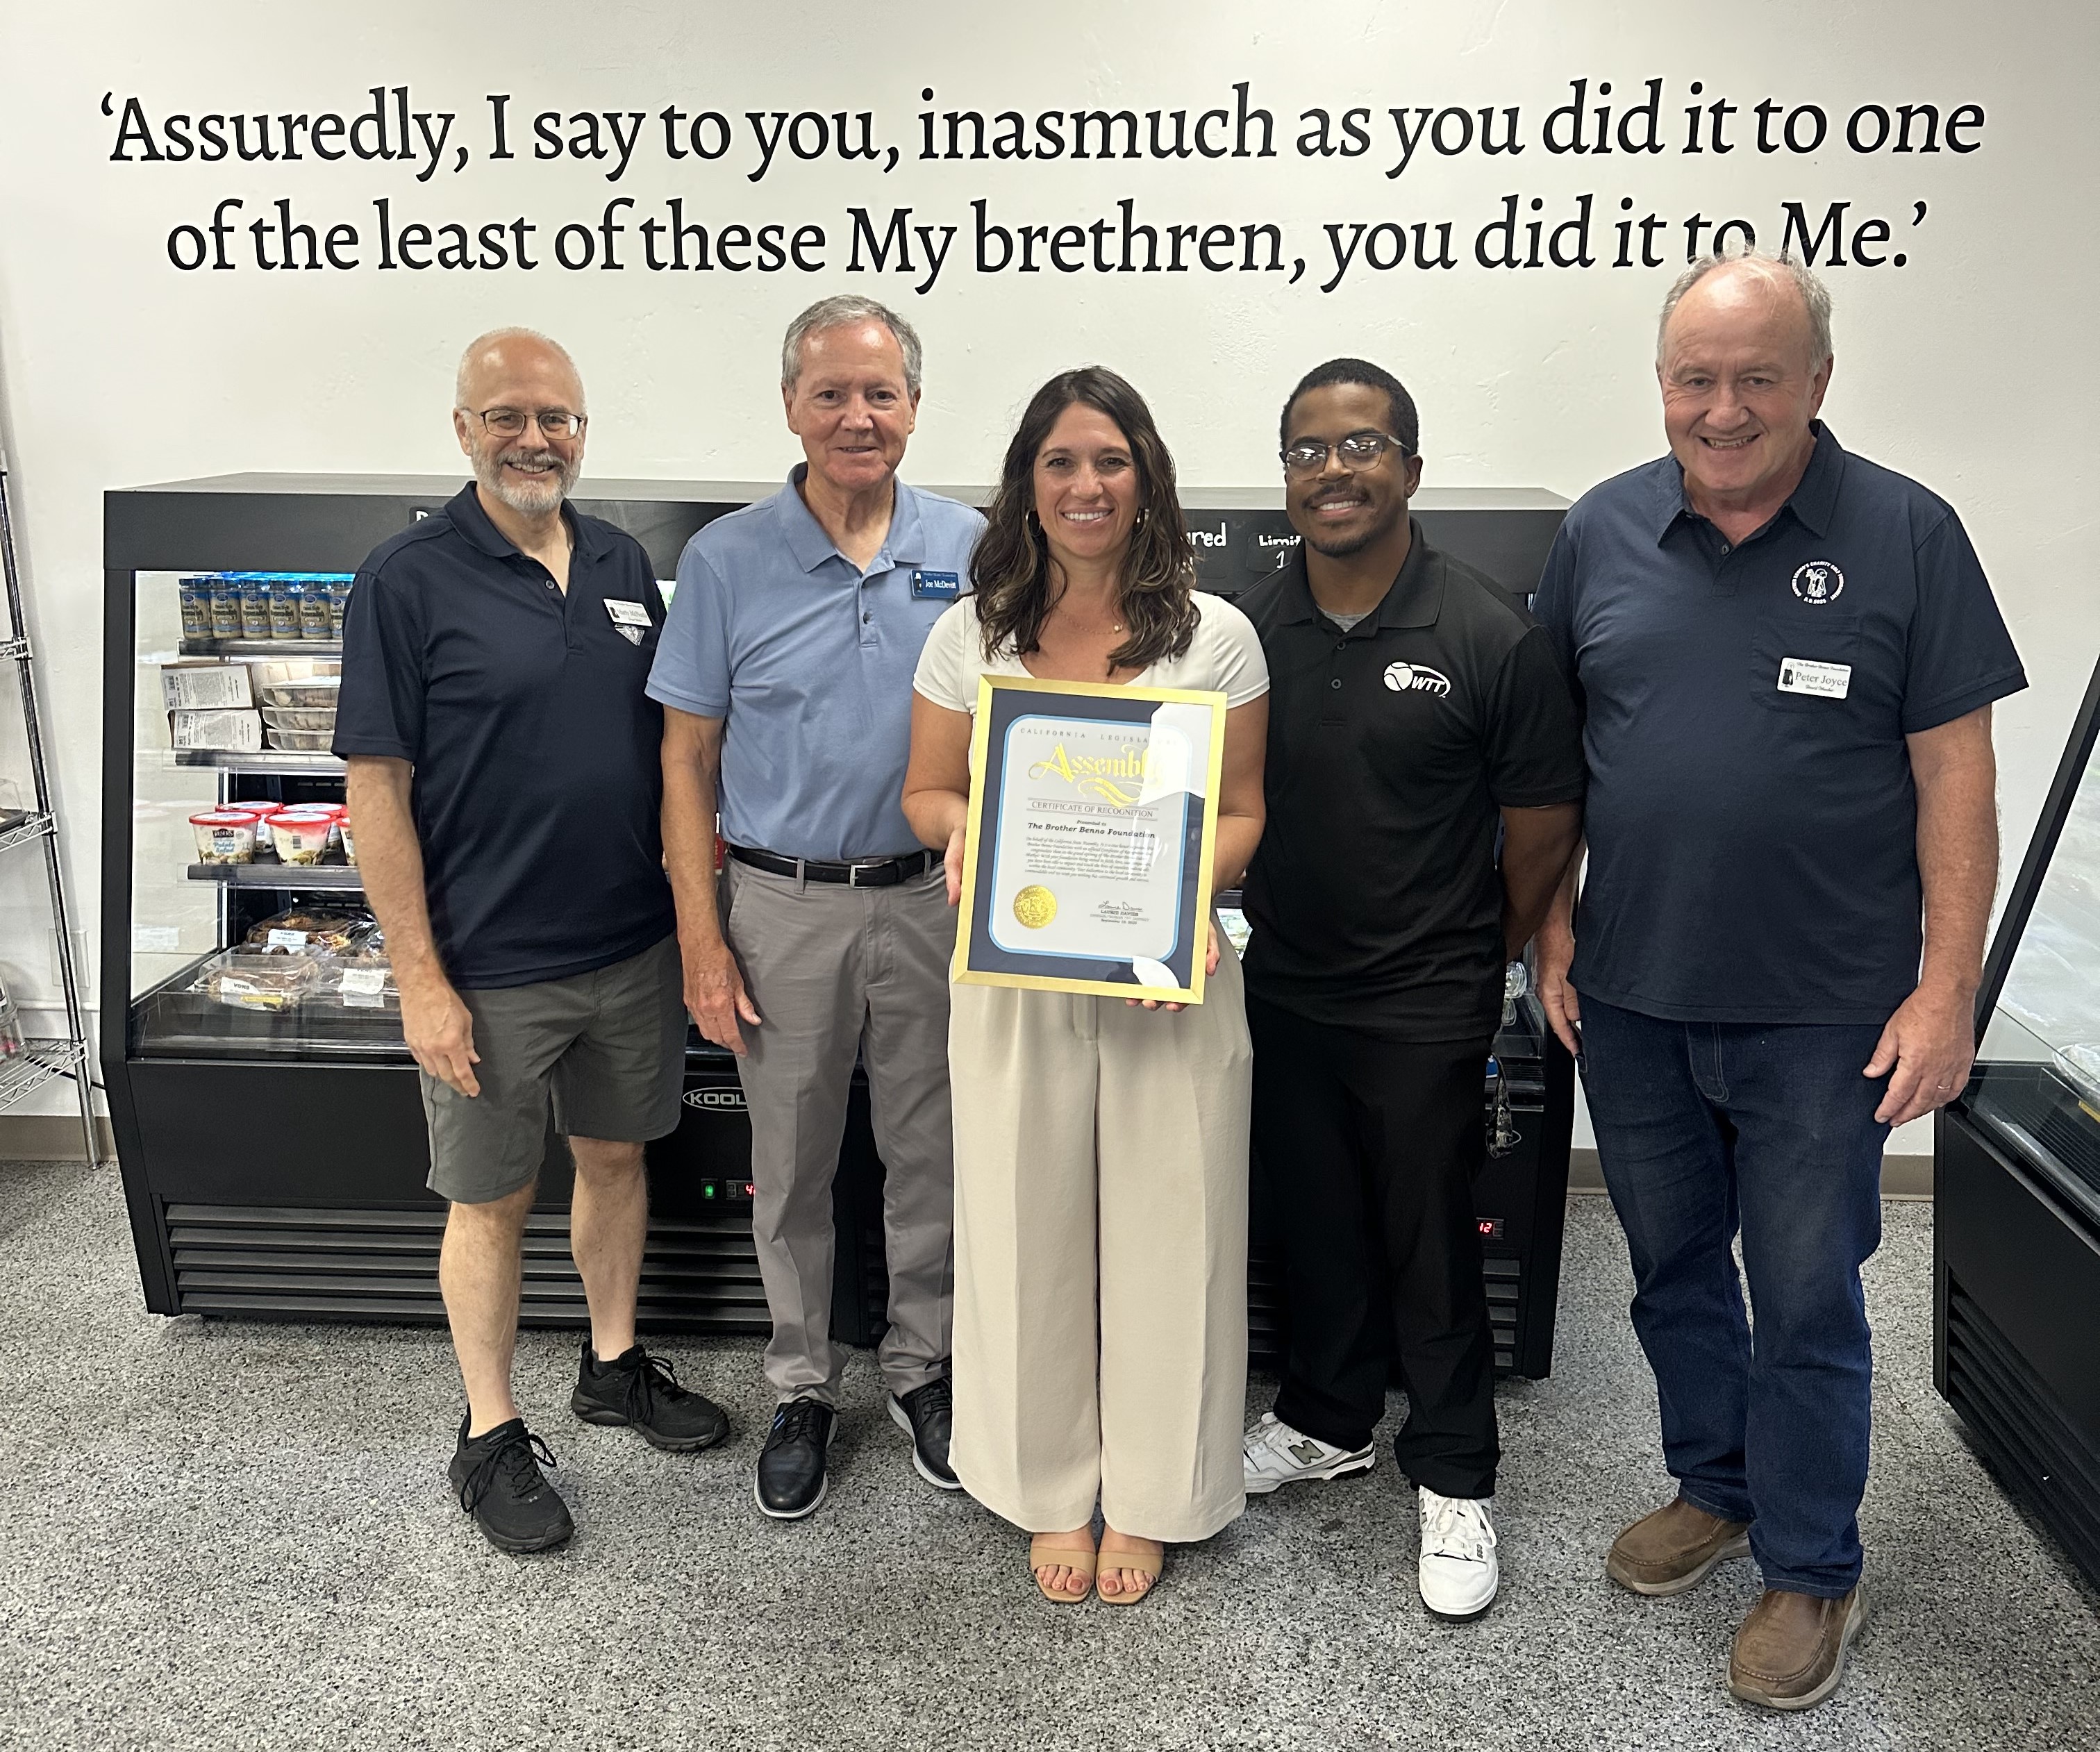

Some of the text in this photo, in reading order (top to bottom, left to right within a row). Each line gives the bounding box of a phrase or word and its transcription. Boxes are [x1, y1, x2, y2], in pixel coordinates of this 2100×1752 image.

[101, 78, 1984, 182] ‘Assuredly, I say to you, inasmuch as you did it to one
[168, 199, 243, 270] of
[249, 199, 359, 270] the
[373, 198, 538, 269] least
[555, 198, 635, 270] of
[640, 198, 825, 272] these
[847, 208, 957, 294] My
[970, 199, 1305, 284] brethren,
[1321, 222, 1458, 293] you
[1475, 194, 1595, 268] did
[1612, 197, 1667, 267] it
[1683, 212, 1756, 265] to
[1258, 535, 1301, 547] Limit
[1276, 551, 1284, 568] 1
[925, 579, 933, 587] Joe
[1411, 676, 1445, 692] WTT
[1795, 671, 1847, 687] Peter Joyce
[1020, 728, 1085, 739] CALIFORNIA
[1032, 801, 1082, 812] CERTIFICATE
[1097, 806, 1153, 817] RECOGNITION
[1045, 824, 1077, 833] Brother
[1079, 826, 1105, 835] Benno
[1107, 829, 1155, 839] Foundation
